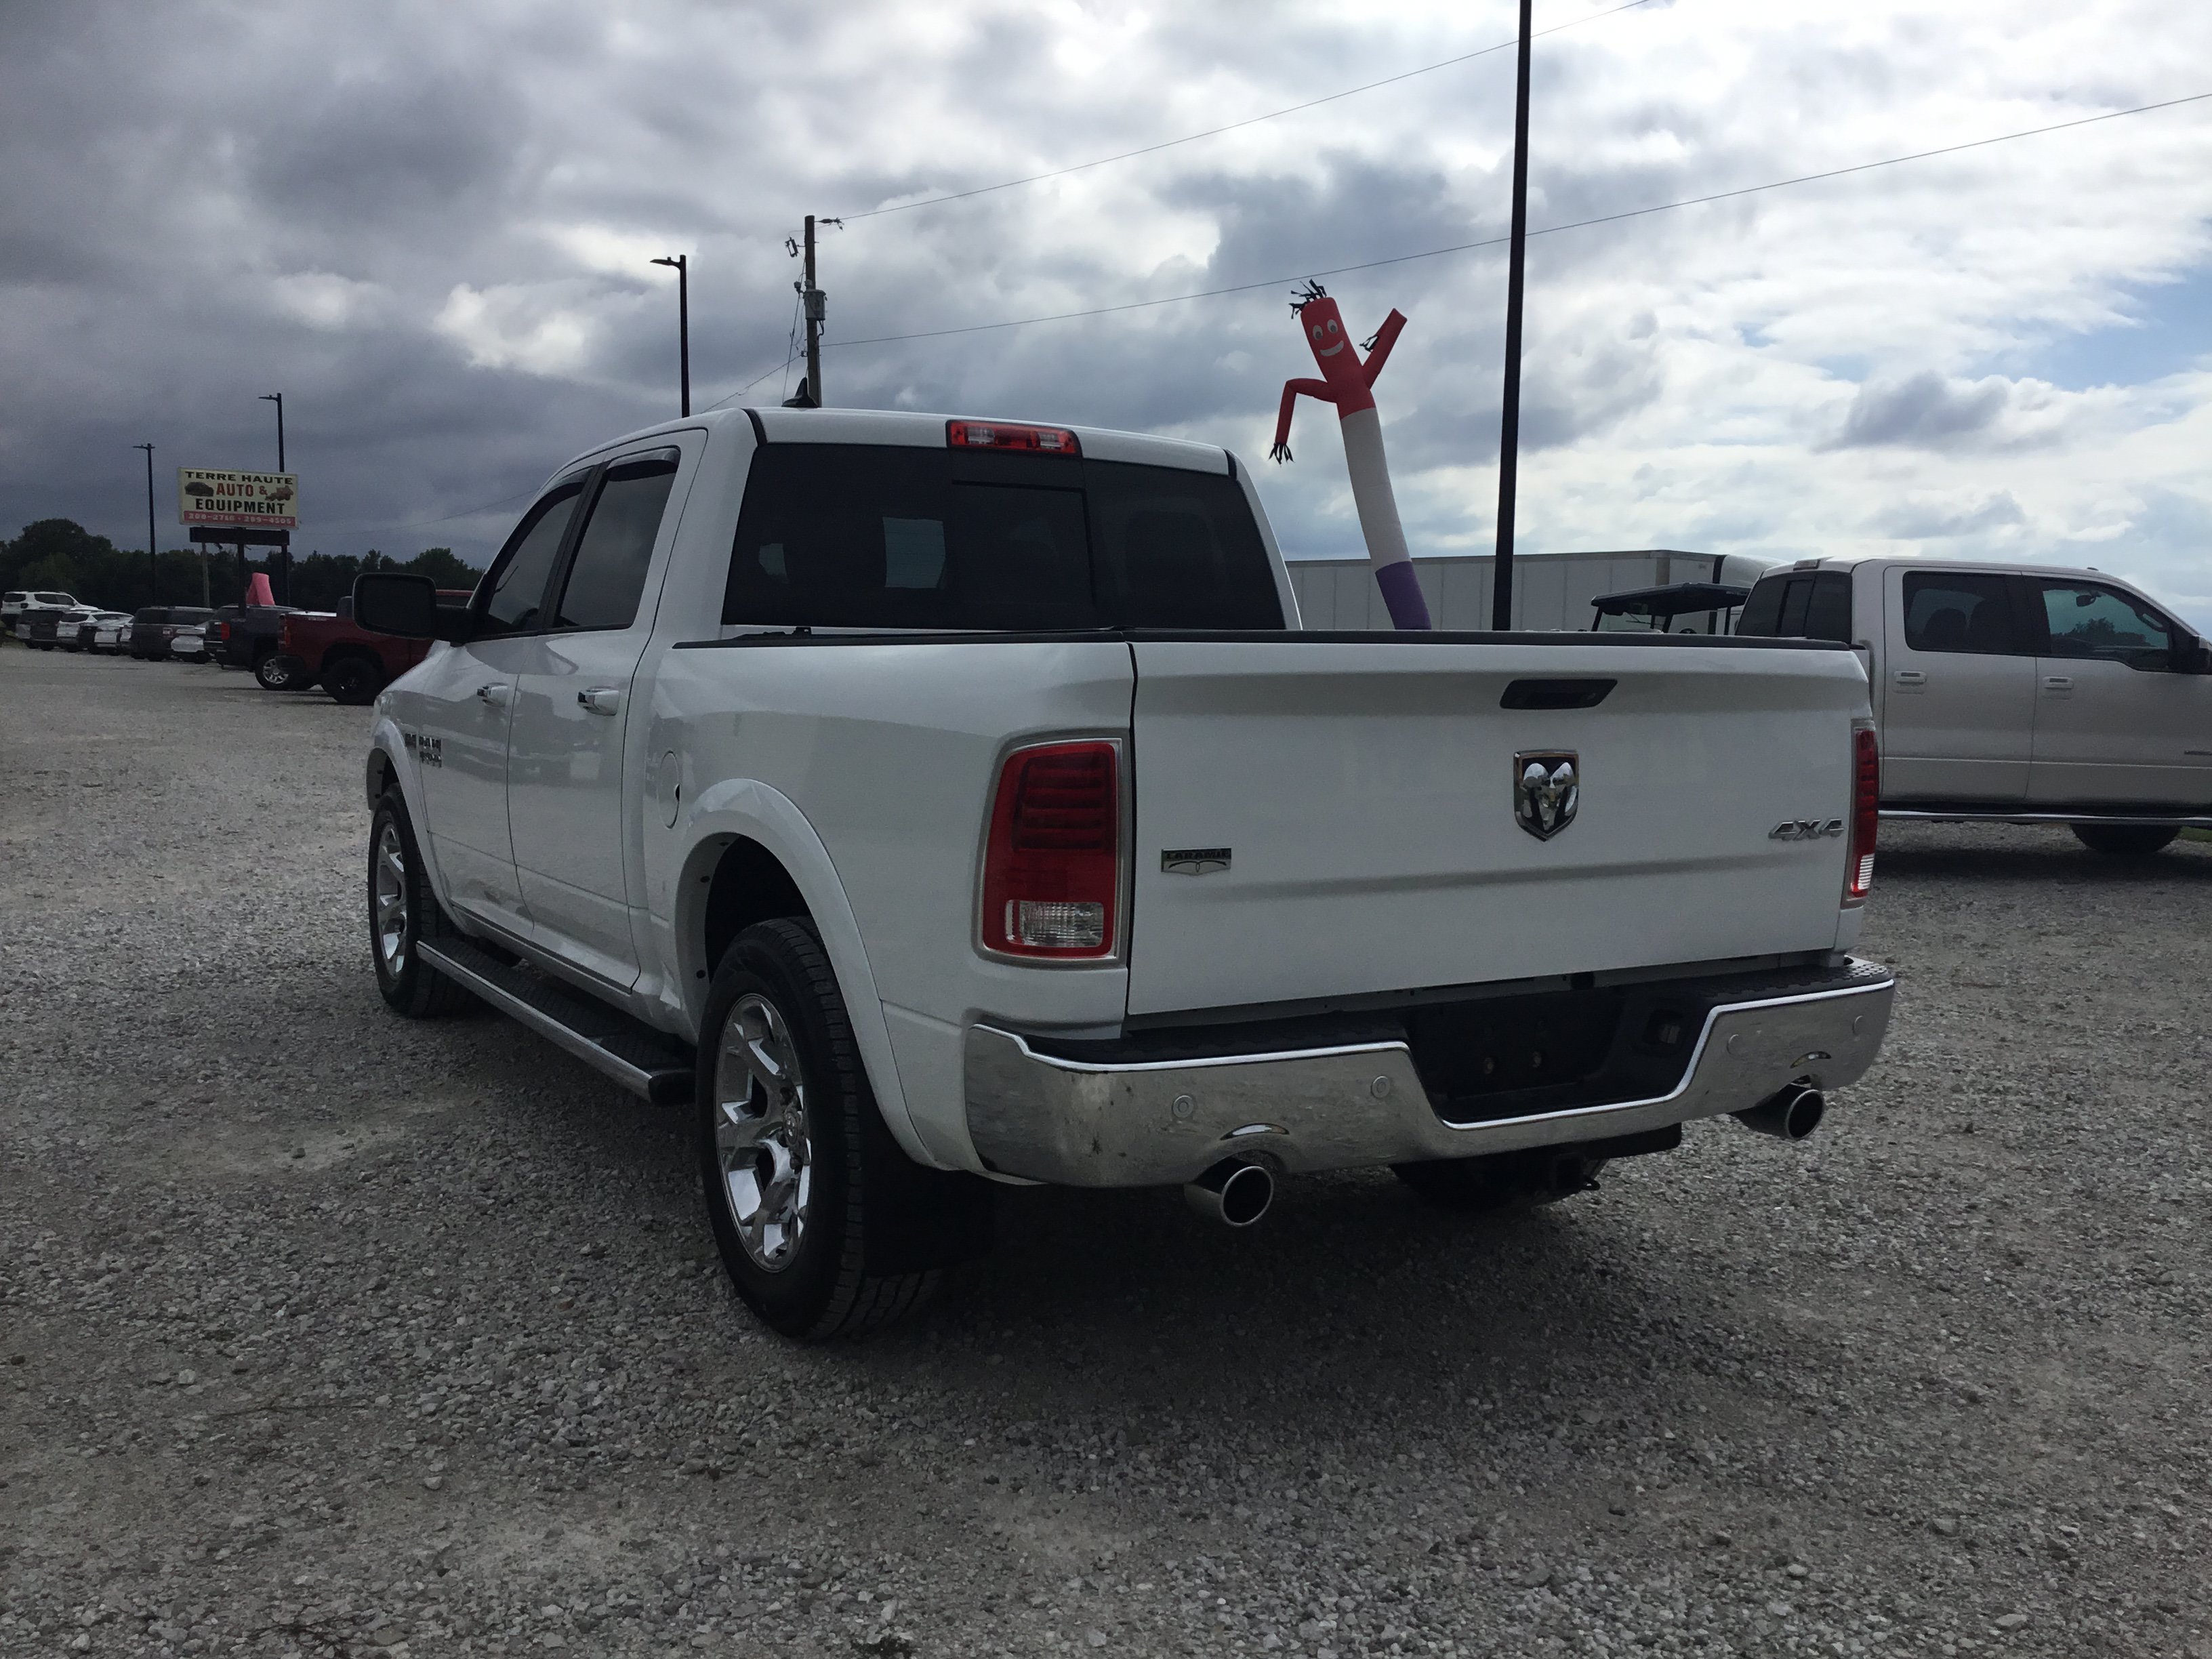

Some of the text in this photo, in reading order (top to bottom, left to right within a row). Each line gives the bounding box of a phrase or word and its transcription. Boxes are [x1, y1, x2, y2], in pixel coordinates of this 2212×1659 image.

[185, 471, 293, 485] TERRE HAUTE
[216, 483, 268, 497] AUTO &
[195, 498, 285, 514] EQUIPMENT
